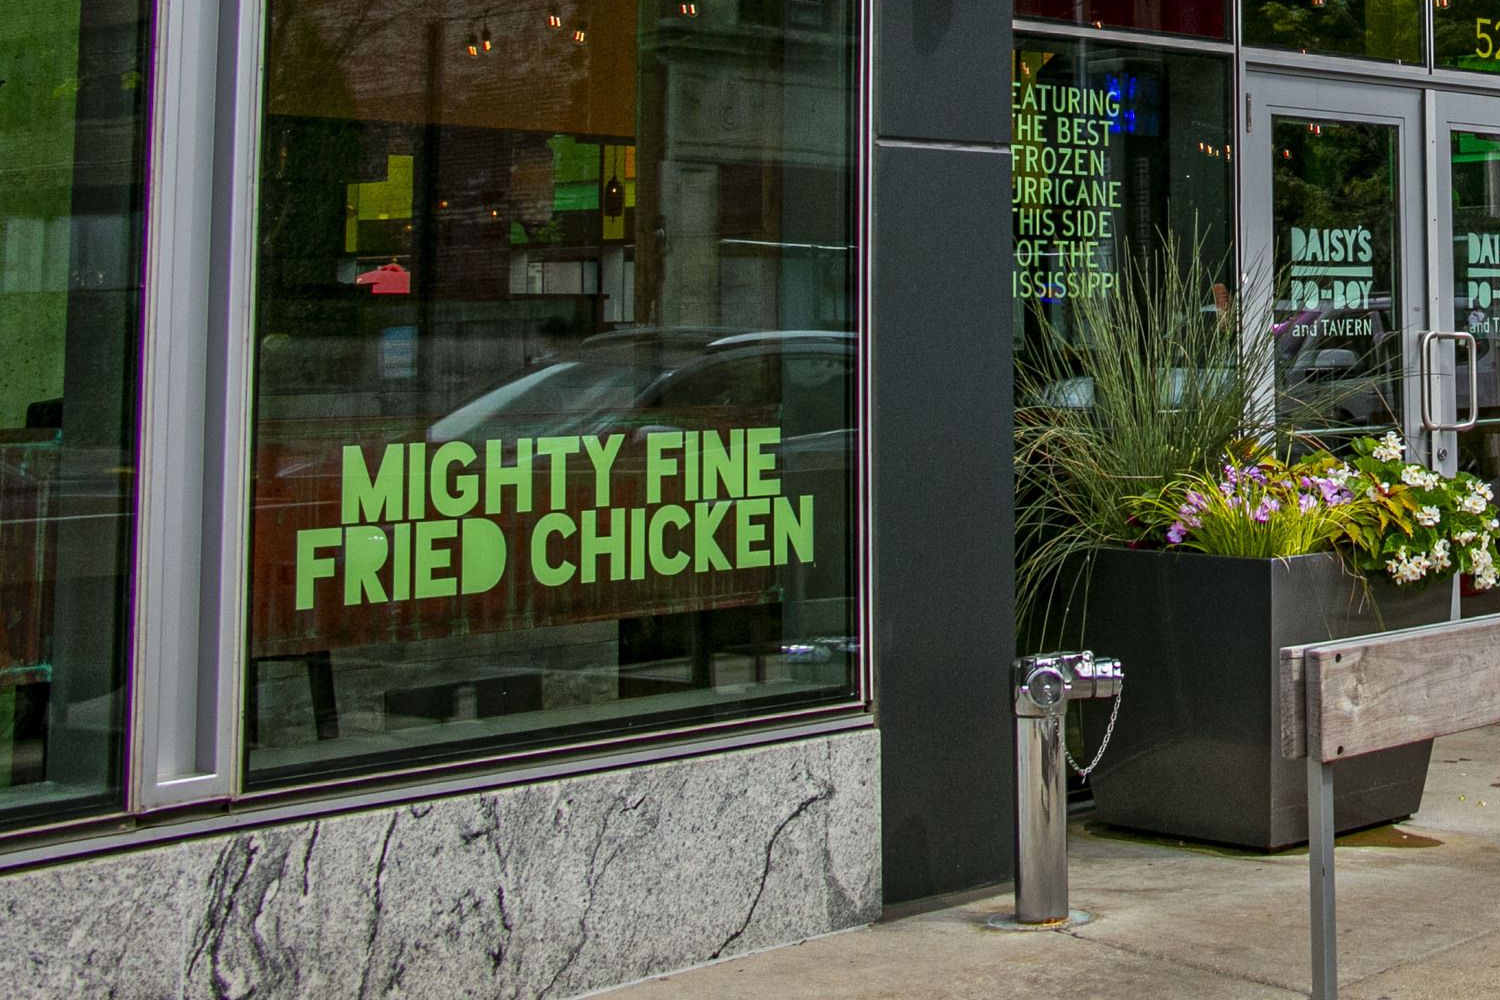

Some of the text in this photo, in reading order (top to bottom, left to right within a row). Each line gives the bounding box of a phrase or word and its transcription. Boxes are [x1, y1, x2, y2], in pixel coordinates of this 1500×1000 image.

[1011, 82, 1120, 117] EATURING
[1012, 113, 1114, 146] HE BEST
[1010, 145, 1104, 176] FROZEN
[1012, 176, 1121, 208] URRICANE
[1012, 208, 1112, 237] HIS SIDE
[1017, 240, 1099, 268] OF THE
[1291, 225, 1373, 262] DAISY'S
[1013, 271, 1119, 299] ISSISSIPPI
[1291, 280, 1373, 310] PO-BOY
[1292, 318, 1372, 337] and TAVERN
[1469, 317, 1490, 333] and
[341, 427, 782, 525] MIGHTY FINE
[296, 495, 814, 611] FRIED CHICKEN
